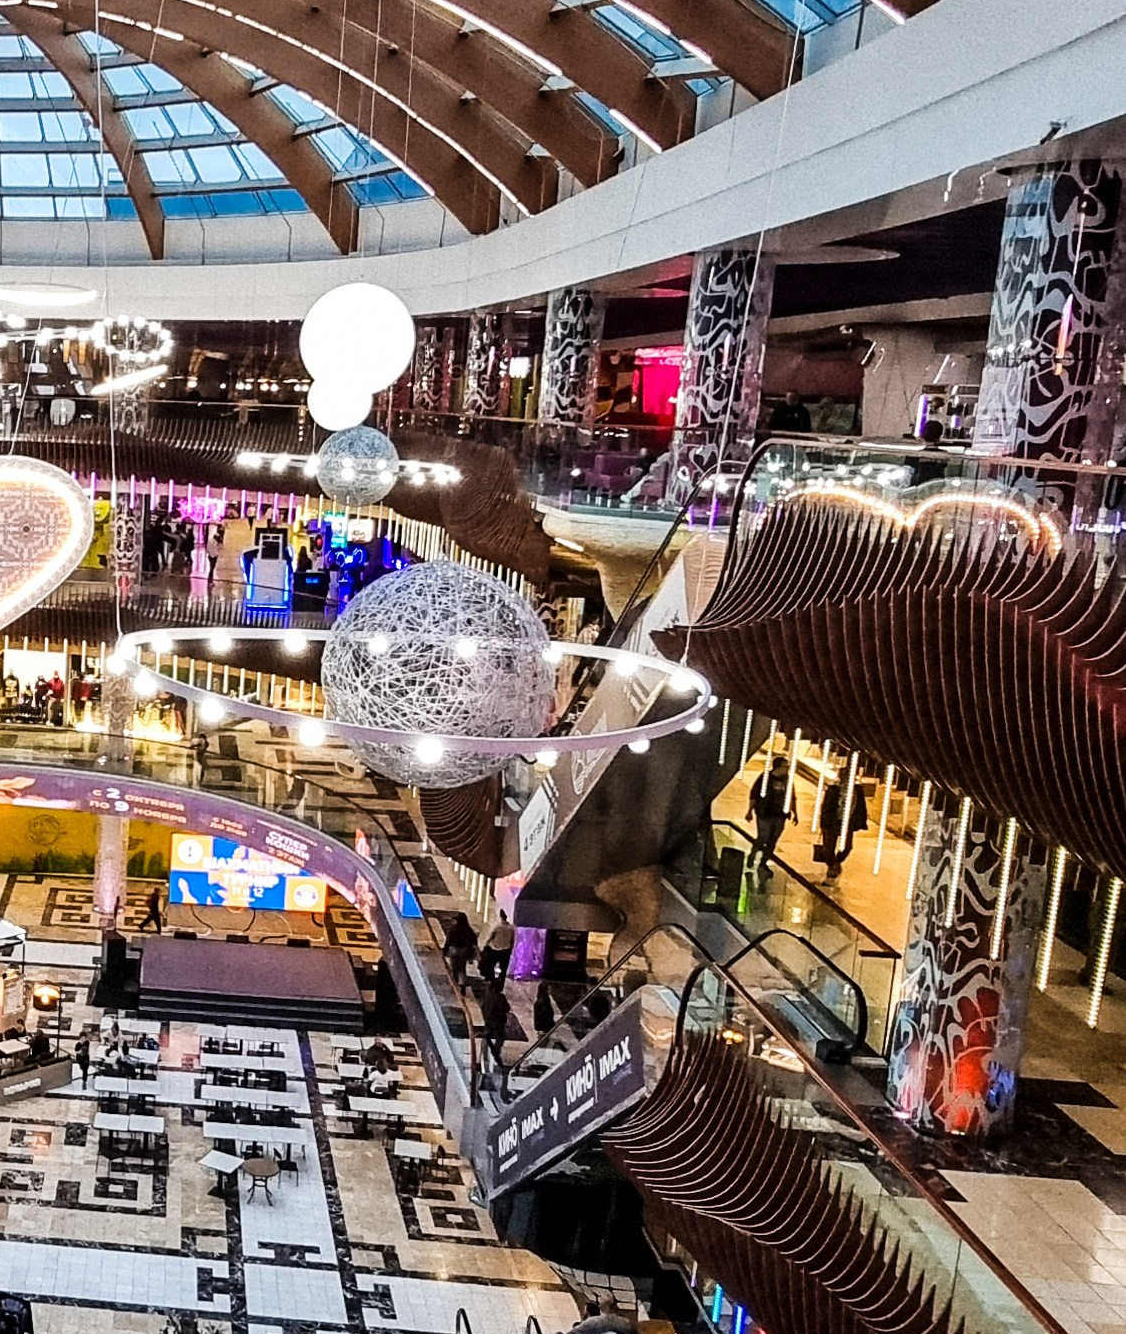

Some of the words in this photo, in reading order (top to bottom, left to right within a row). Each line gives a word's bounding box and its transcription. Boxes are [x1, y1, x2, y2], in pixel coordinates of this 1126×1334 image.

[106, 788, 121, 799] 2
[124, 794, 185, 811] ОКТЯБРЯ
[89, 800, 110, 809] ПО
[114, 801, 129, 812] 9
[134, 807, 187, 824] НОЯБРЯ
[265, 836, 310, 861] КОШКИ
[268, 831, 308, 851] СУПЕР
[276, 850, 306, 868] ЭТАЖ
[223, 873, 280, 888] ТУРНИР
[253, 887, 264, 897] 12
[599, 1035, 631, 1080] IMAX
[521, 1106, 544, 1140] IMAX
